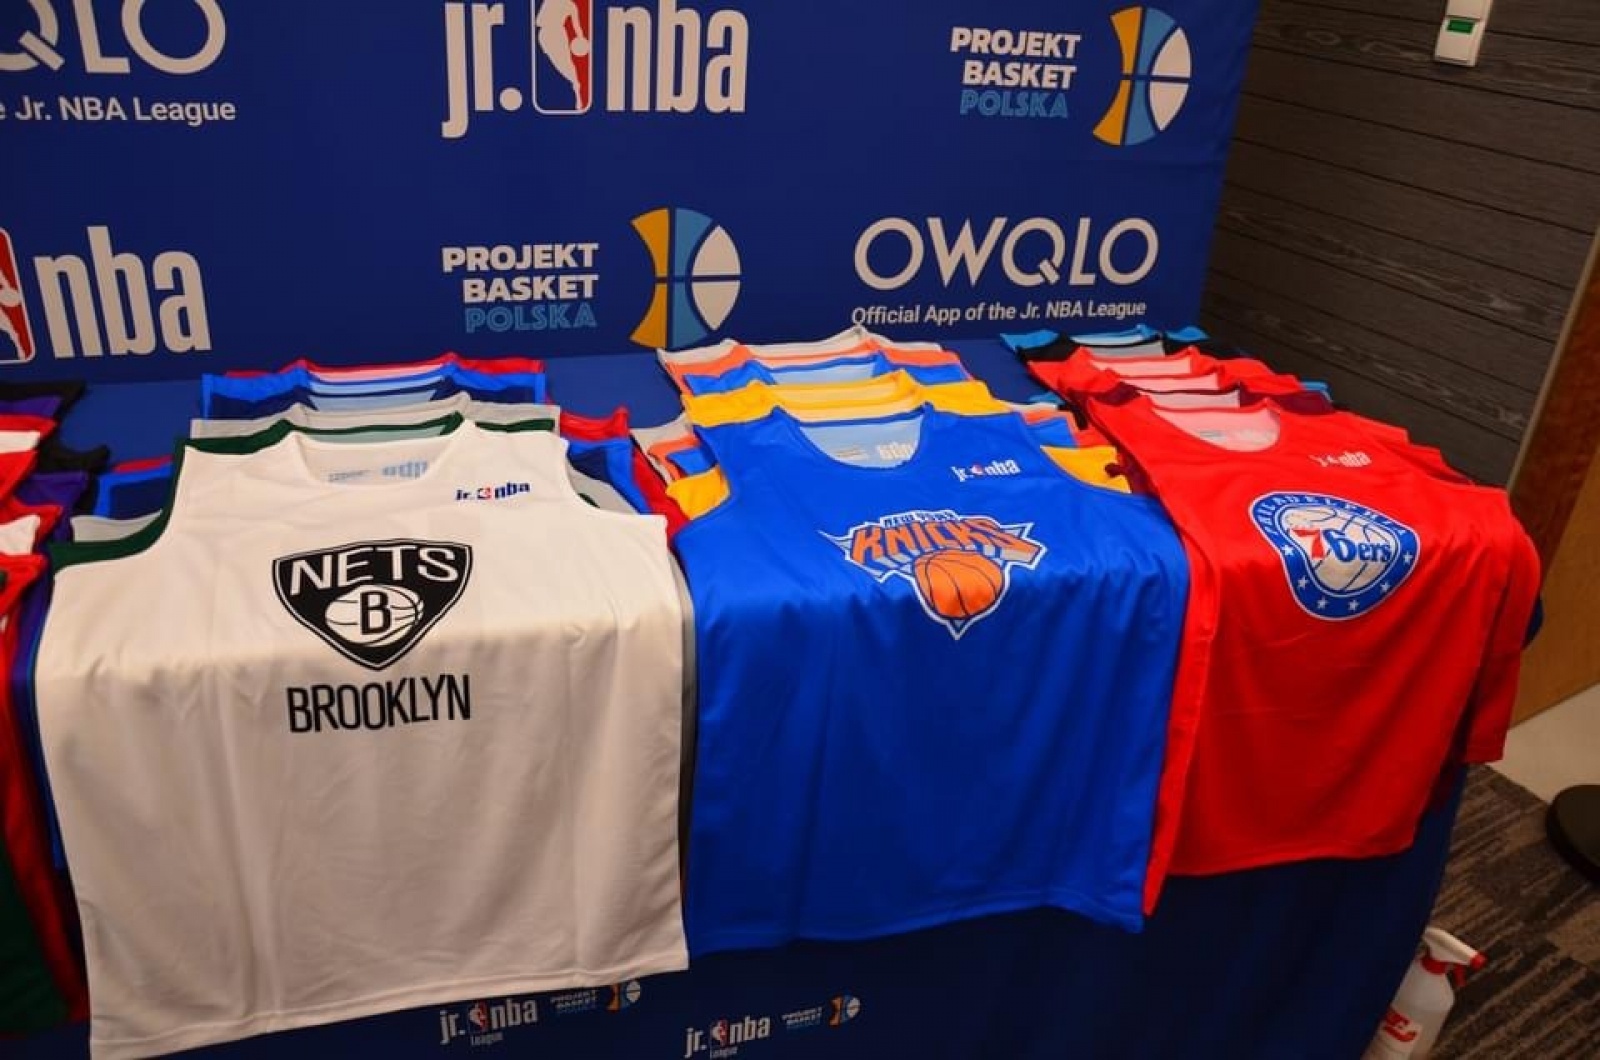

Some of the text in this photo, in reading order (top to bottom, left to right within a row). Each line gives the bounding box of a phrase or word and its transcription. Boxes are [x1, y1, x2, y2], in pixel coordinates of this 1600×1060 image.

[950, 26, 1081, 59] PROJEKT
[442, 0, 749, 138] jr. nba
[962, 60, 1077, 89] BASKET
[15, 96, 51, 121] Jr.
[58, 97, 128, 121] NBA
[133, 97, 236, 127] League
[959, 90, 1069, 119] POLSKA
[442, 243, 599, 273] PROJEKT
[854, 217, 1159, 290] OWQLO
[33, 226, 212, 359] nba
[463, 273, 599, 303] BASKET
[465, 302, 598, 333] POLSKA
[852, 299, 1147, 327] Official App of the Jr. NBA League
[984, 459, 1021, 476] nba
[852, 516, 1043, 565] KNICKS
[1289, 526, 1392, 563] 76ers
[290, 545, 459, 596] NETS
[360, 590, 393, 636] B
[286, 674, 471, 733] BROOKLYN
[440, 997, 538, 1045] jr. nba
[684, 1016, 771, 1059] jr. nba
